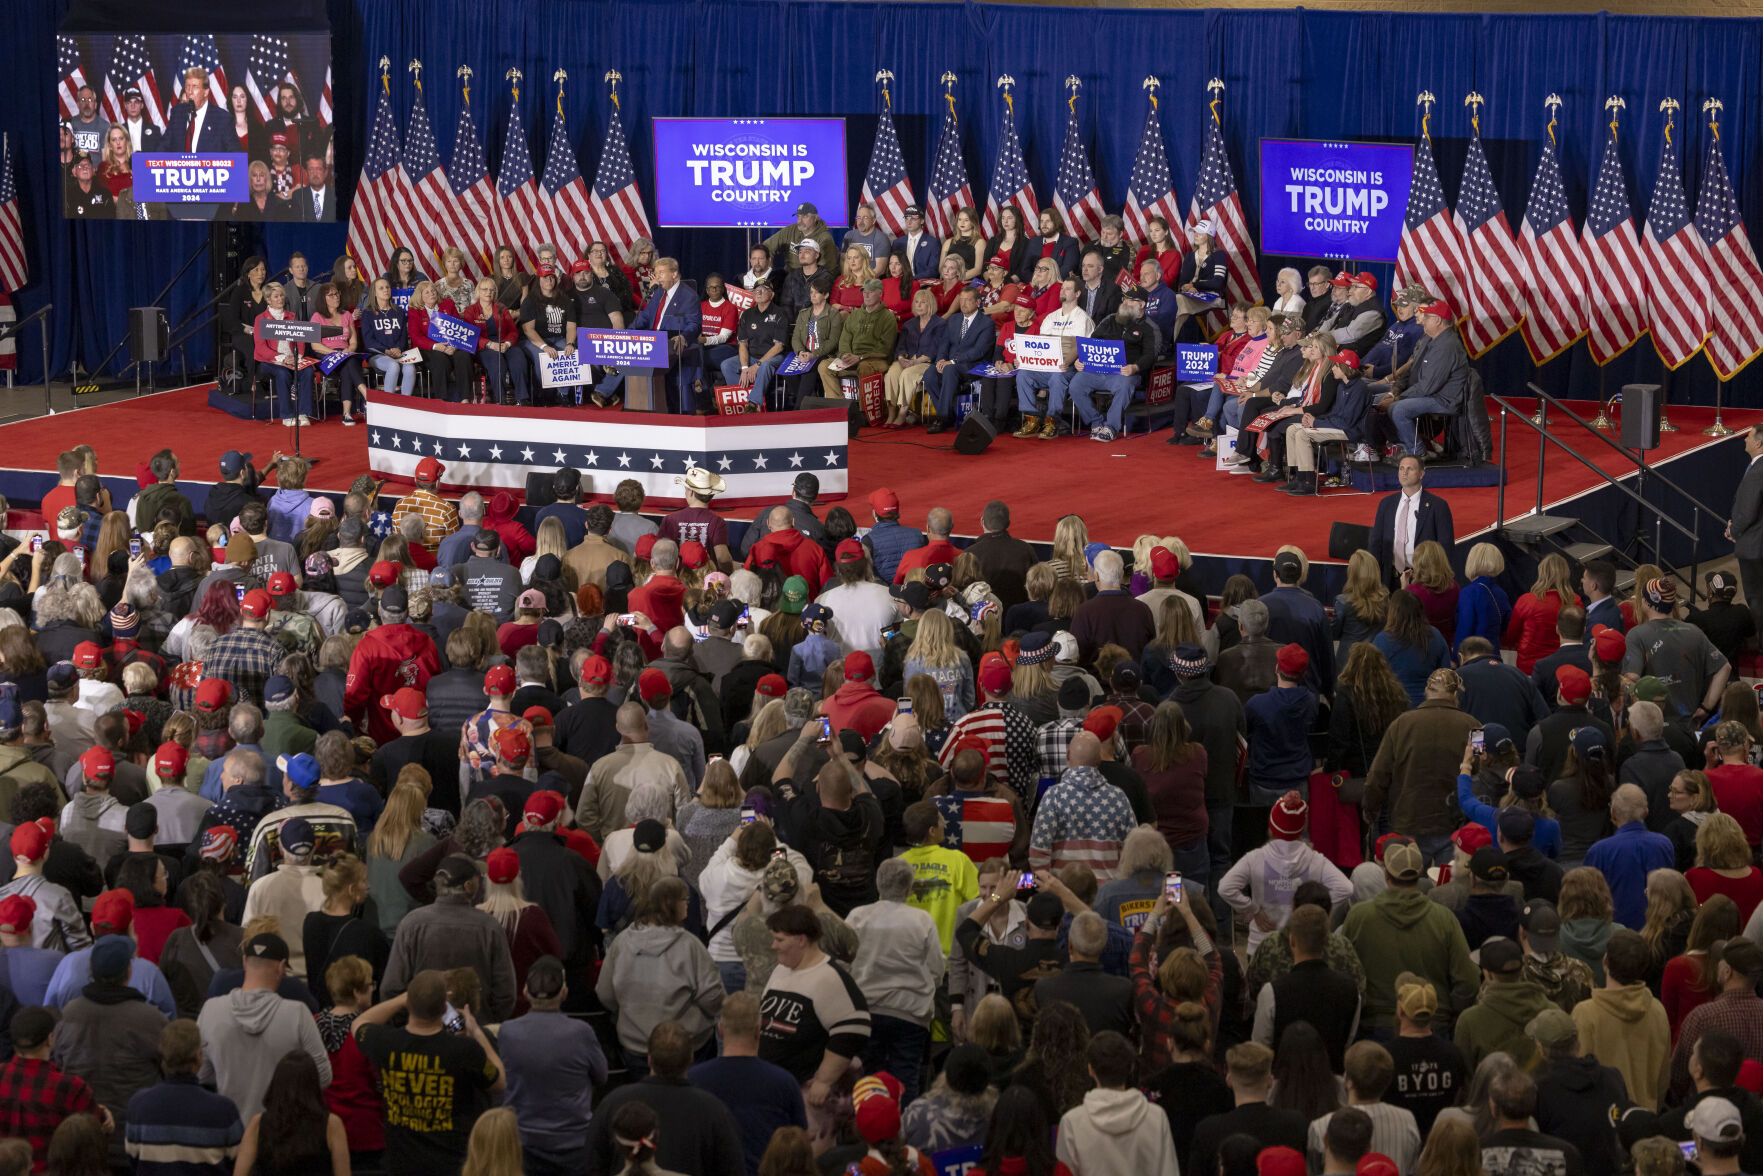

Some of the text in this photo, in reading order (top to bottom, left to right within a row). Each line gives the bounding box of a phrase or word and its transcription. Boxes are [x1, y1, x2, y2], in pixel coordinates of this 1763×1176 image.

[692, 144, 808, 157] WISCONSIN IS
[151, 168, 230, 186] TRUMP
[686, 160, 815, 186] TRUMP
[1290, 167, 1383, 185] WISCONSIN IS
[711, 190, 792, 202] COUNTRY
[1285, 184, 1389, 217] TRUMP
[1304, 217, 1369, 234] COUNTRY
[374, 318, 401, 330] USA
[436, 317, 475, 336] TRUMP
[438, 327, 468, 342] 2024
[592, 340, 653, 355] TRUMP
[1024, 340, 1050, 350] ROAD
[1081, 343, 1120, 356] TRUMP
[553, 353, 576, 362] MAKE
[1019, 355, 1059, 366] VICTORY
[1087, 353, 1115, 364] 2024
[1181, 350, 1214, 361] TRUMP
[552, 367, 579, 376] GREAT
[1185, 360, 1209, 370] 2024
[551, 374, 581, 383] AGAIN!
[1153, 371, 1172, 388] FIRE
[722, 390, 752, 404] FIR
[863, 381, 875, 421] FIRE
[872, 379, 880, 418] BIDEN
[724, 405, 746, 415] BID
[255, 554, 274, 566] NTI
[1121, 900, 1151, 912] BIKERS
[760, 996, 803, 1024] OVE
[389, 1051, 446, 1074] I WILL
[381, 1068, 455, 1096] NEVER
[1398, 1071, 1451, 1092] BYOG
[384, 1087, 453, 1109] APOLOGIZE
